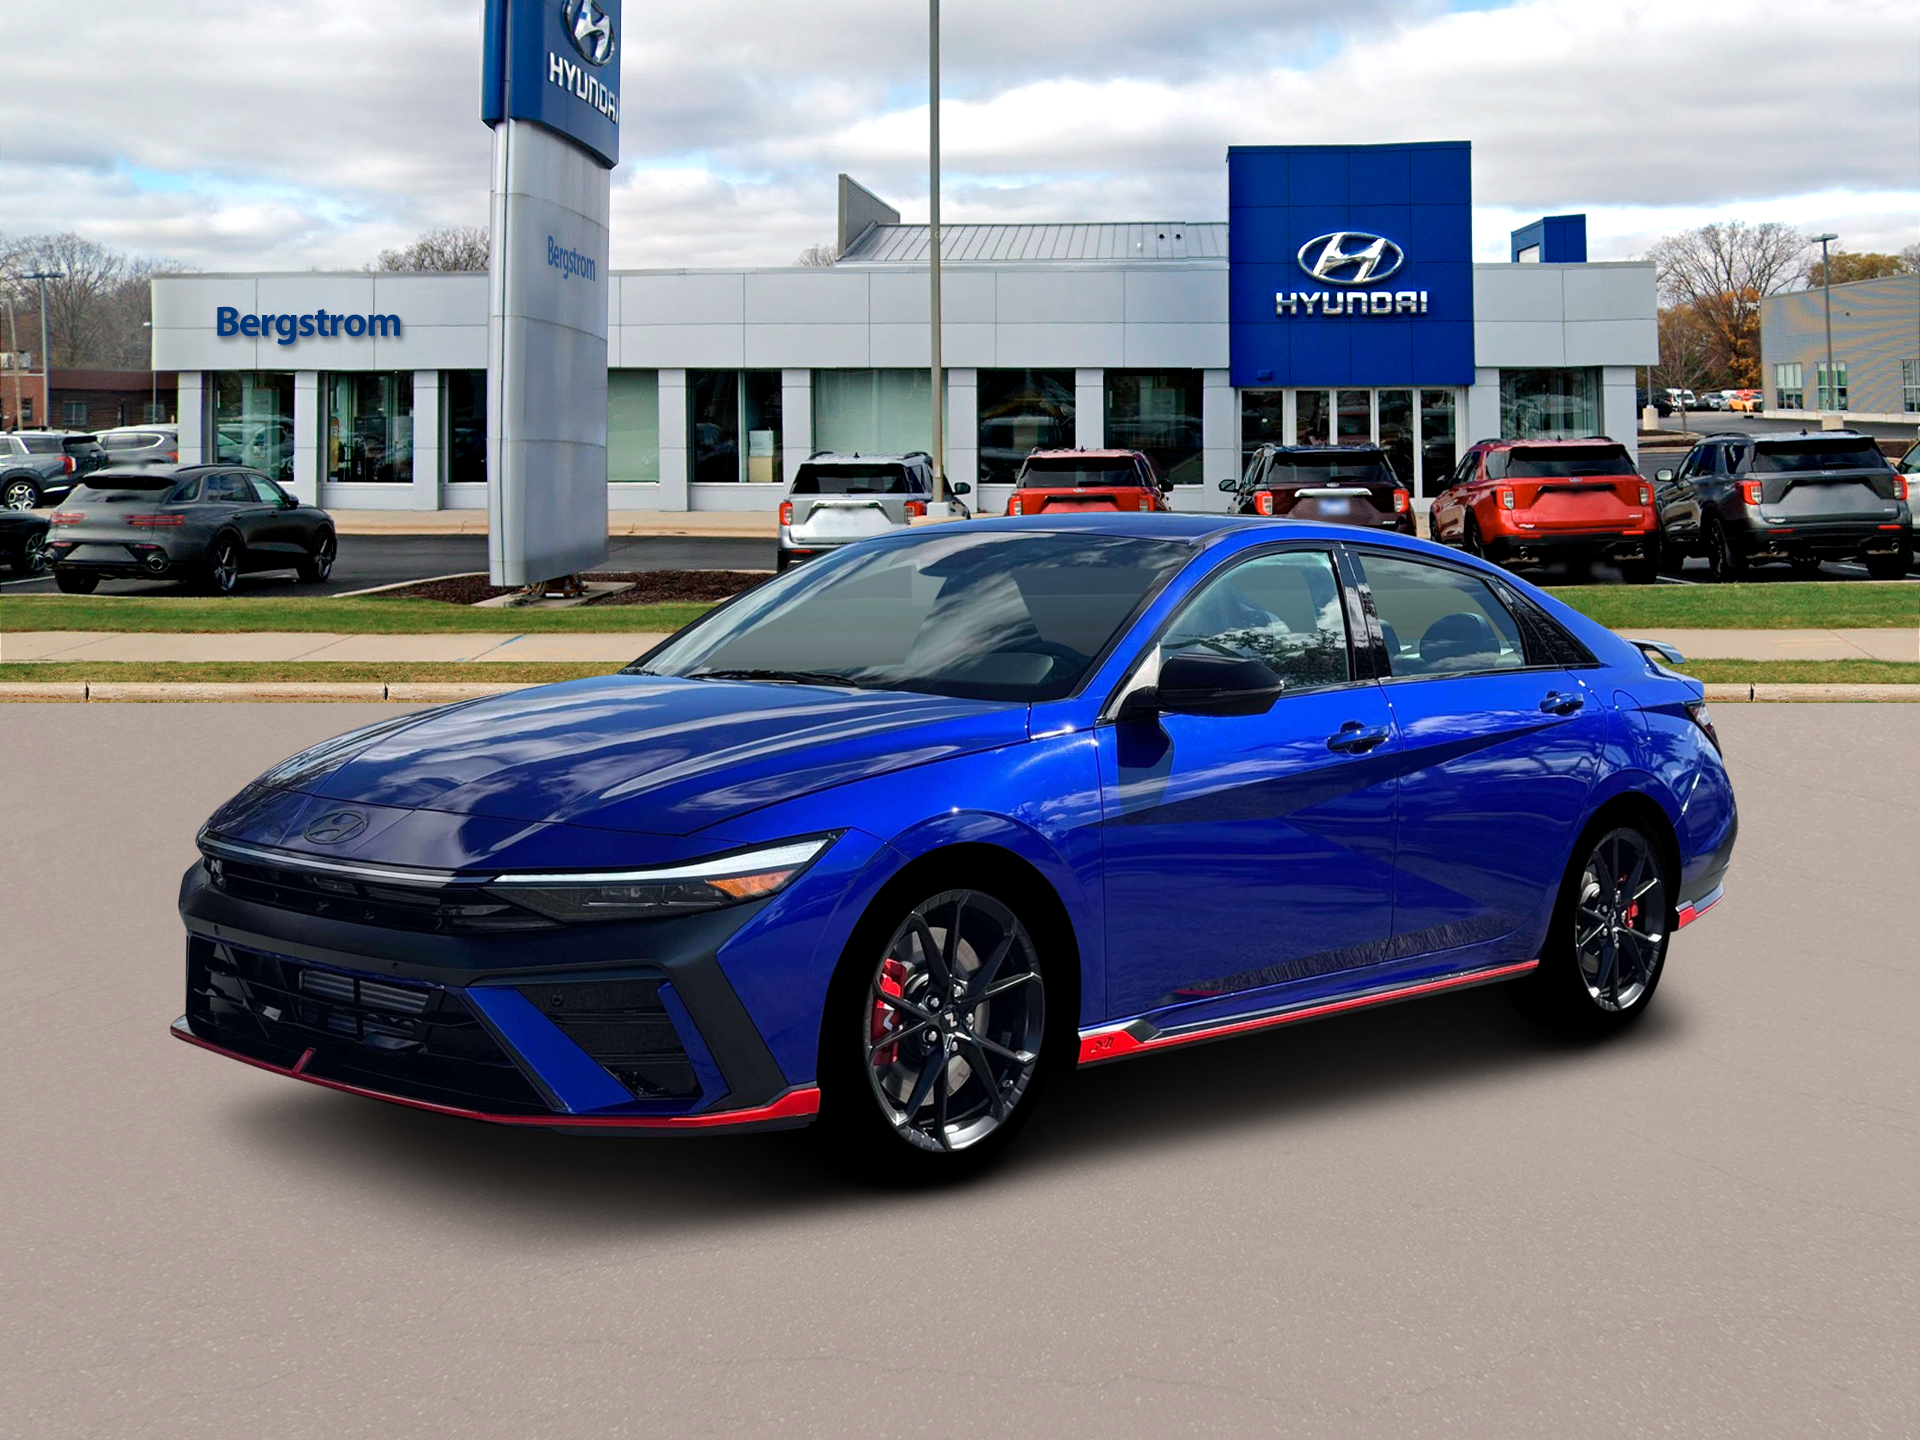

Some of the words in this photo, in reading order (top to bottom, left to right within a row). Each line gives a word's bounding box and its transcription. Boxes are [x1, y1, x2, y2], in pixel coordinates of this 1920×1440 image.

[549, 52, 619, 124] HYUNDAI
[548, 235, 596, 282] Bergstrom
[1275, 291, 1428, 315] HYUNDAI
[216, 306, 402, 347] Bergstrom
